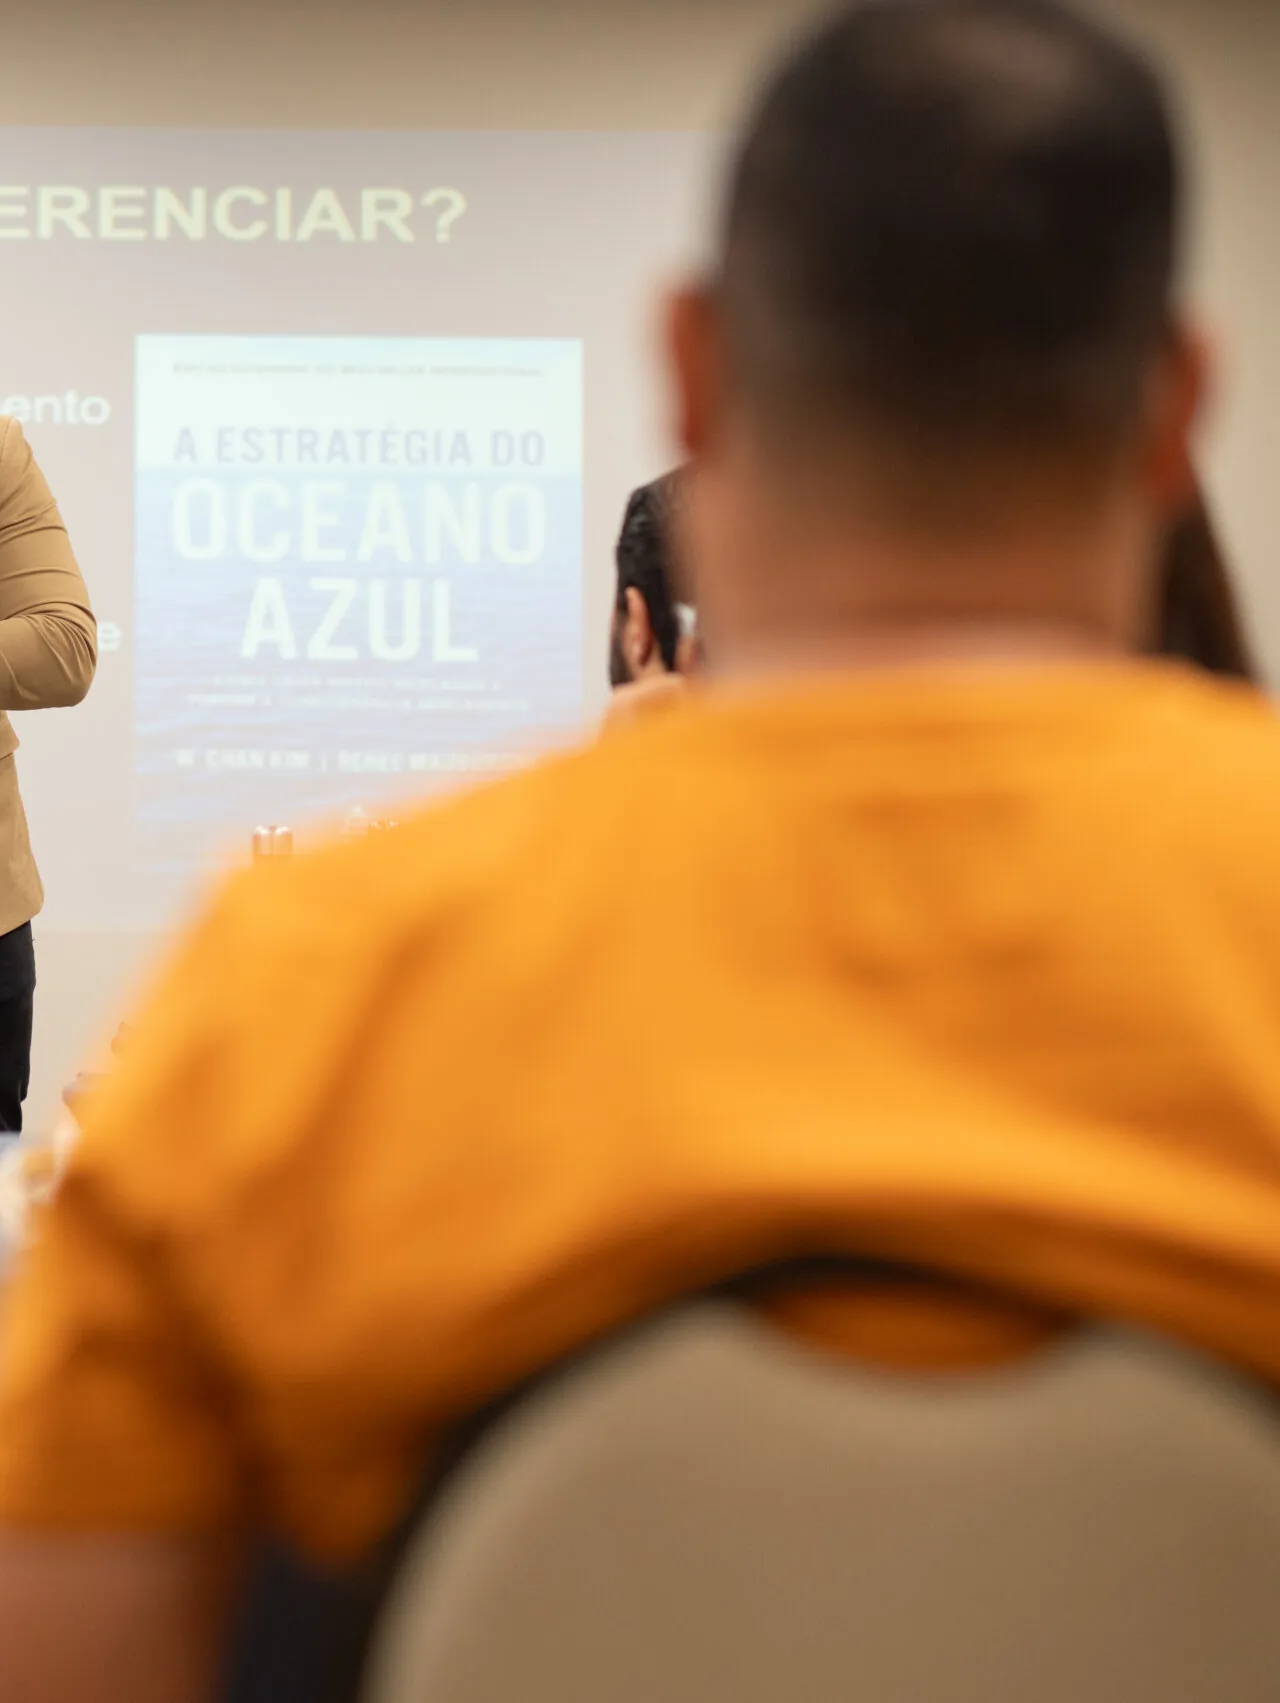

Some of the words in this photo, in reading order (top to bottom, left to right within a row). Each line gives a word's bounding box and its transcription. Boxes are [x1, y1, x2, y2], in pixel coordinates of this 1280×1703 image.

[173, 427, 198, 463] A
[216, 421, 473, 467] ESTRATÉGIA
[490, 430, 547, 467] DO
[172, 475, 548, 566] OCEANO
[239, 576, 481, 664] AZUL
